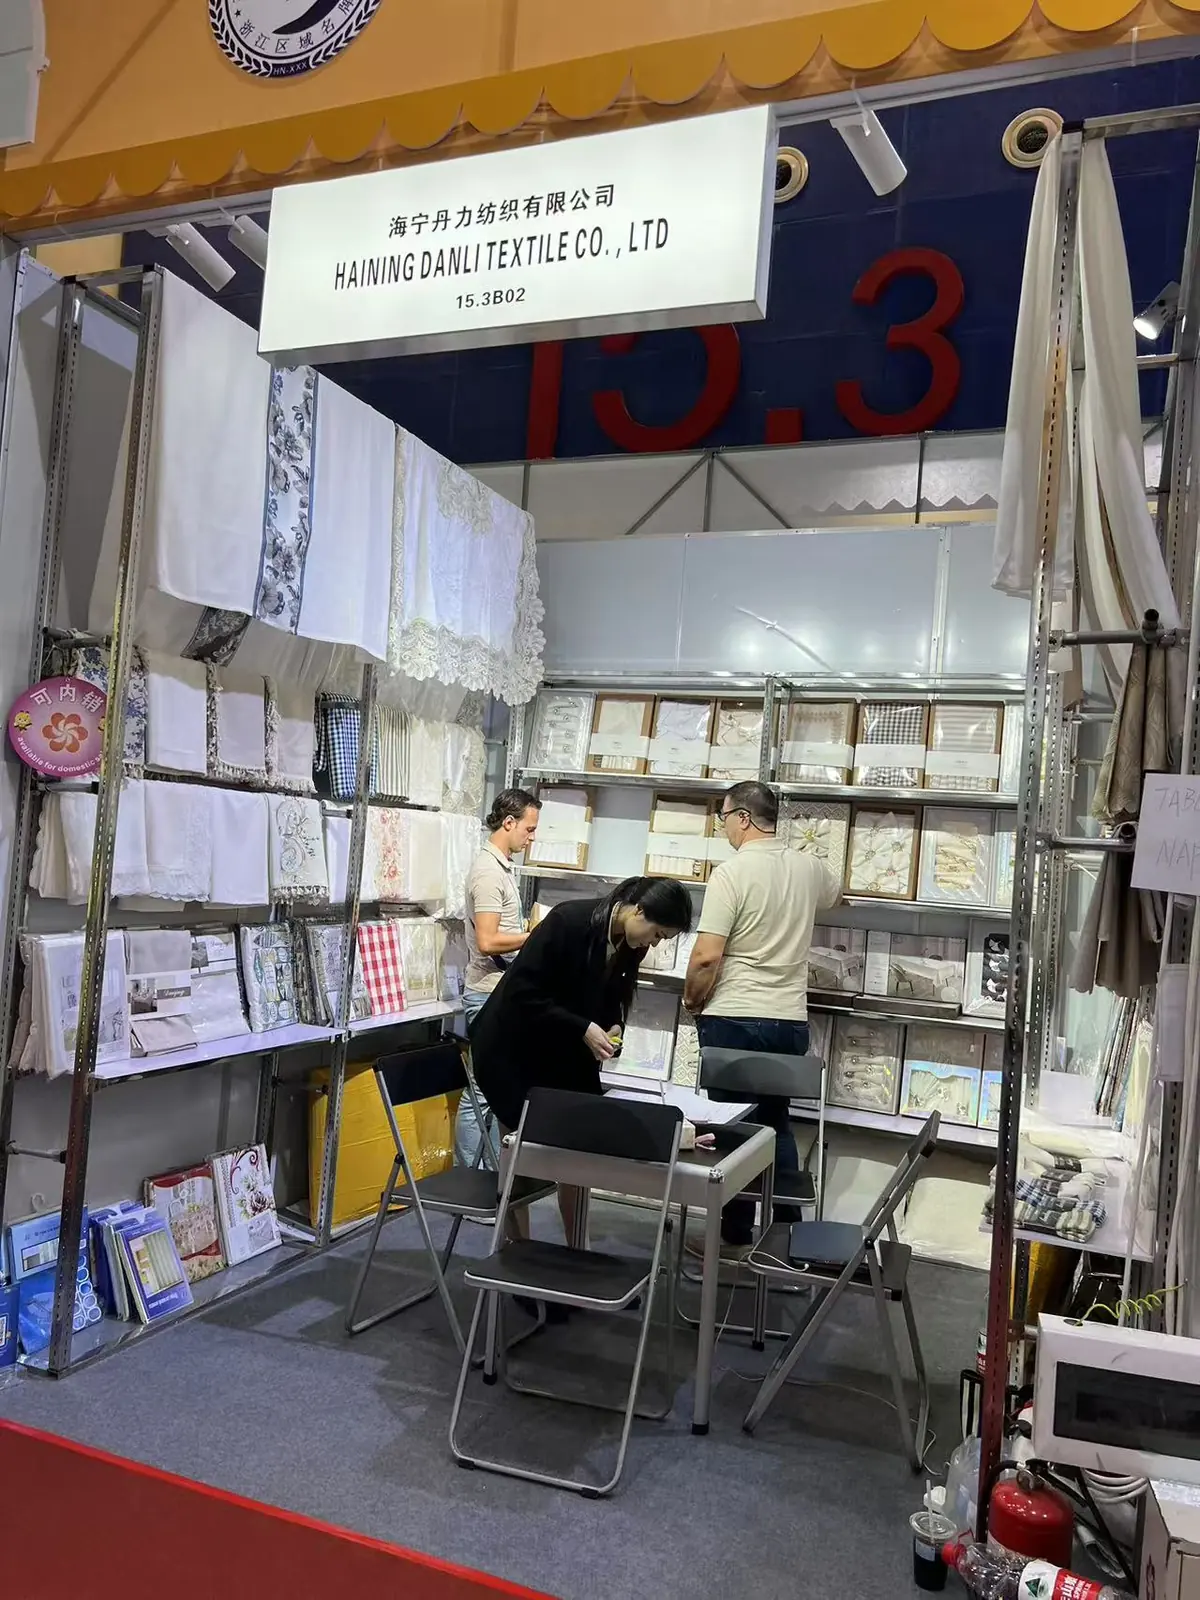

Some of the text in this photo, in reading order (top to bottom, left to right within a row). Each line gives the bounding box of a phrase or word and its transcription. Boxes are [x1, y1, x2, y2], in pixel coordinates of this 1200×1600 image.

[388, 184, 615, 239] 海宁丹力纺织有限公司
[334, 252, 416, 291] HAINING
[420, 243, 481, 280] DANLI
[487, 231, 570, 271] TEXTILE
[455, 287, 526, 310] 15.3B02
[29, 683, 105, 713] 可内销
[17, 736, 43, 766] available
[44, 761, 57, 771] for
[57, 759, 96, 773] domestic
